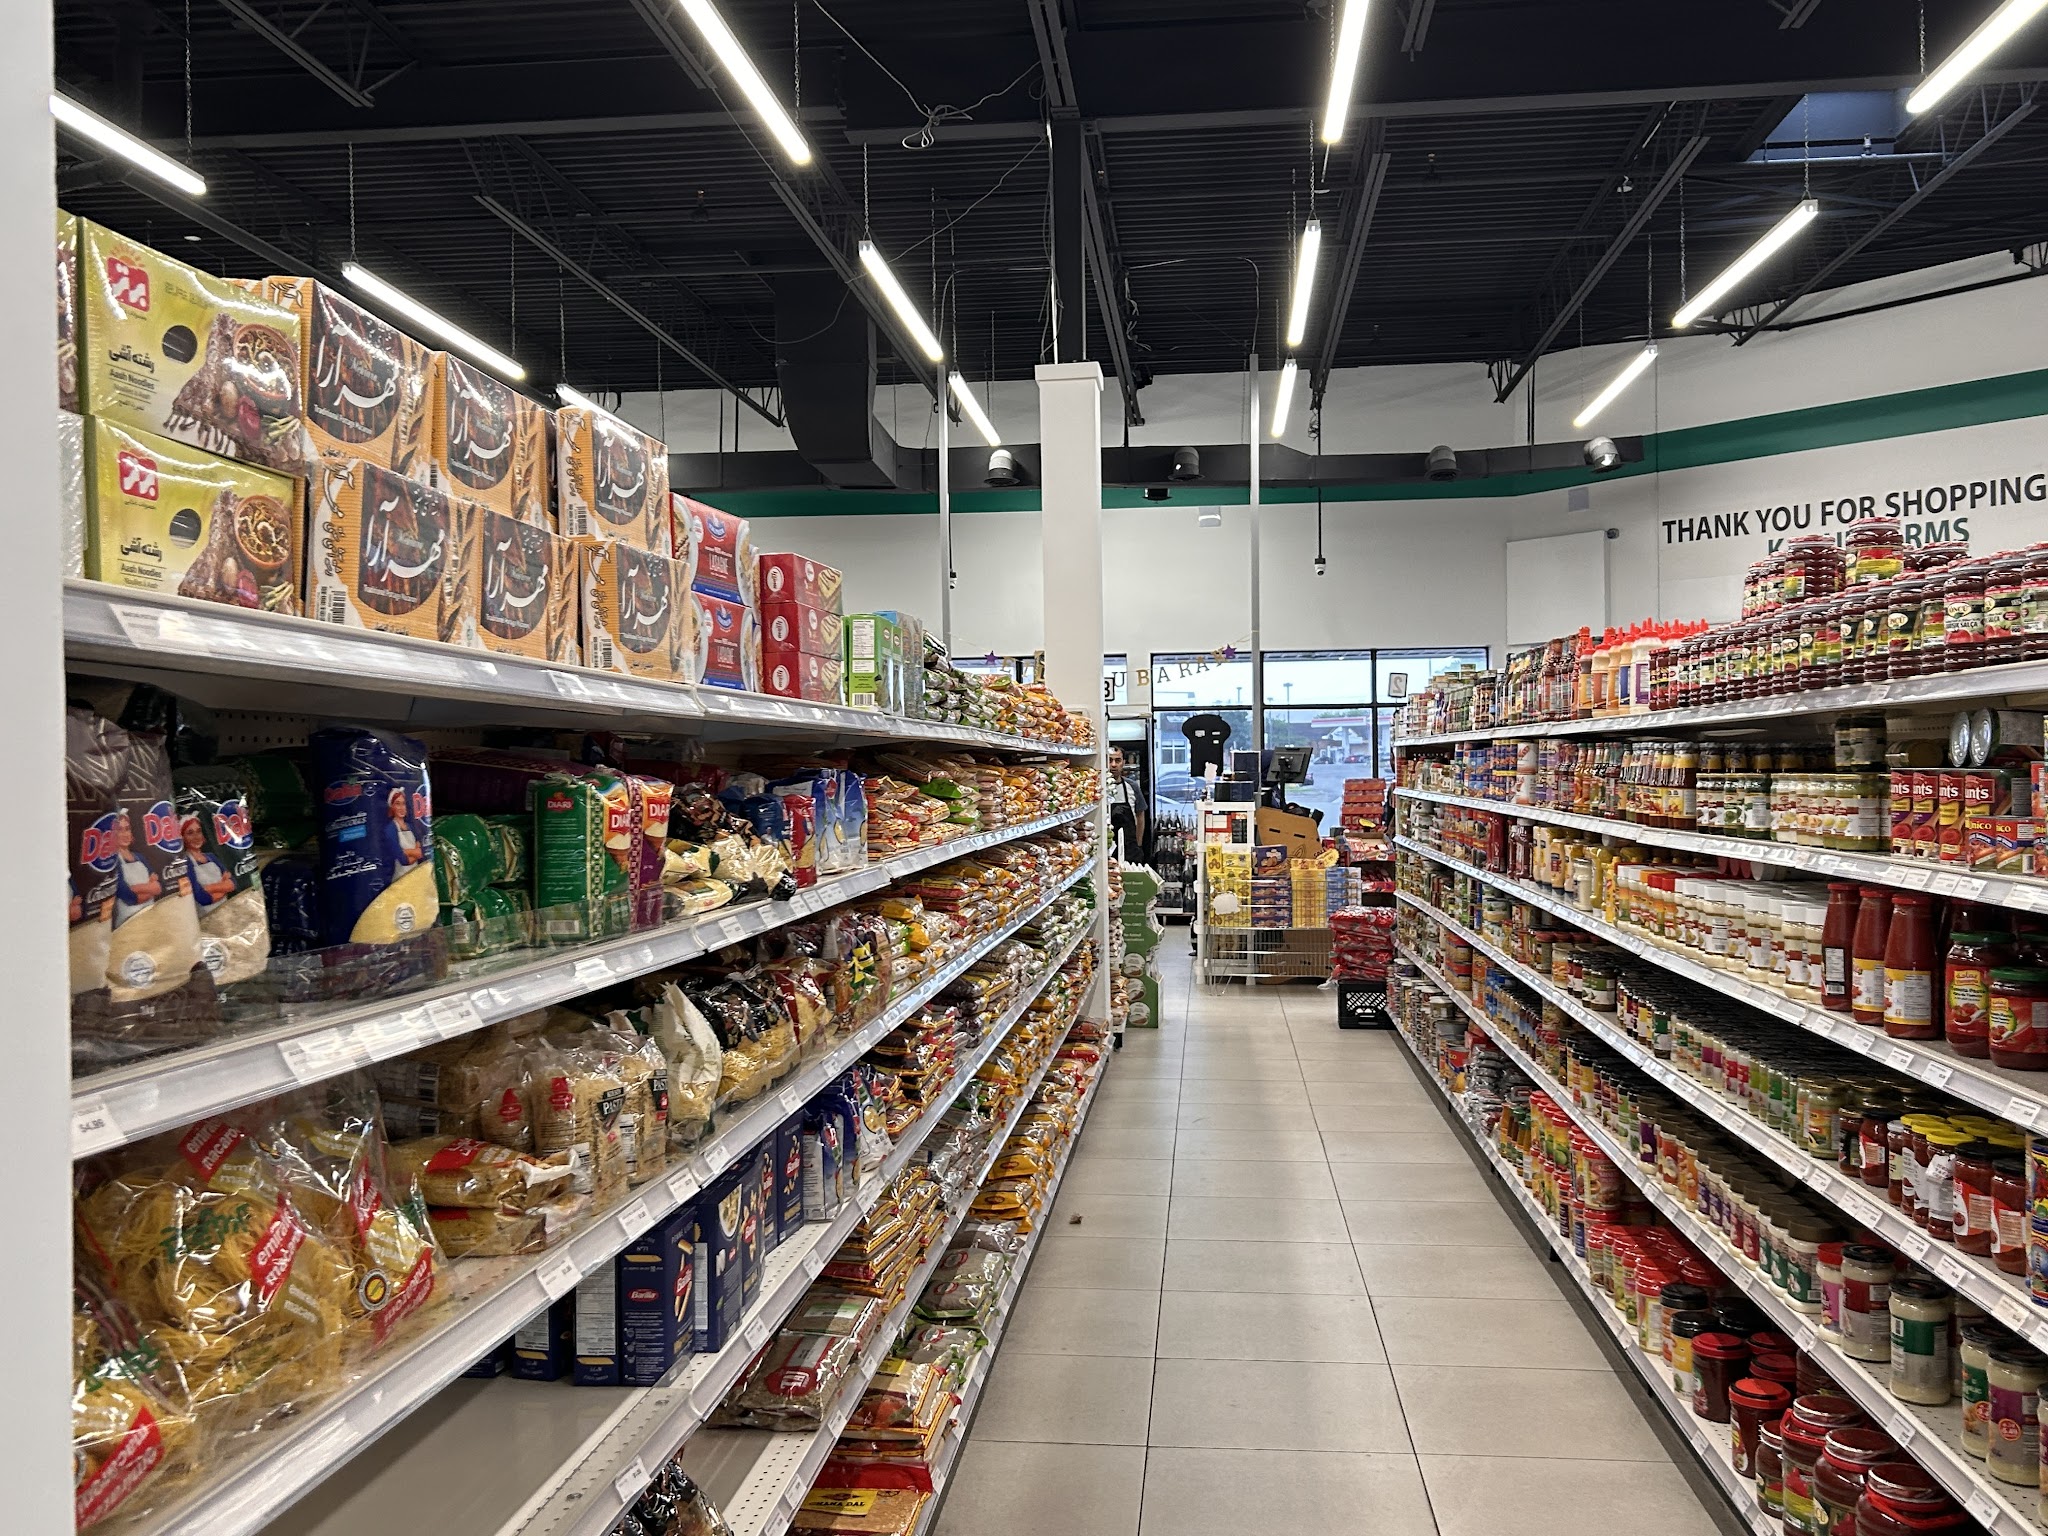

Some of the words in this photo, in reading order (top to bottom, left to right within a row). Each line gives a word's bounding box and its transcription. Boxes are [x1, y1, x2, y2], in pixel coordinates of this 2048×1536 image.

[1662, 511, 1750, 544] THANK
[1756, 503, 1811, 533] YOU
[1821, 495, 1876, 526] FOR
[1884, 473, 2047, 518] SHOPPING
[1965, 785, 1990, 801] unt's
[630, 1290, 657, 1300] Barilla
